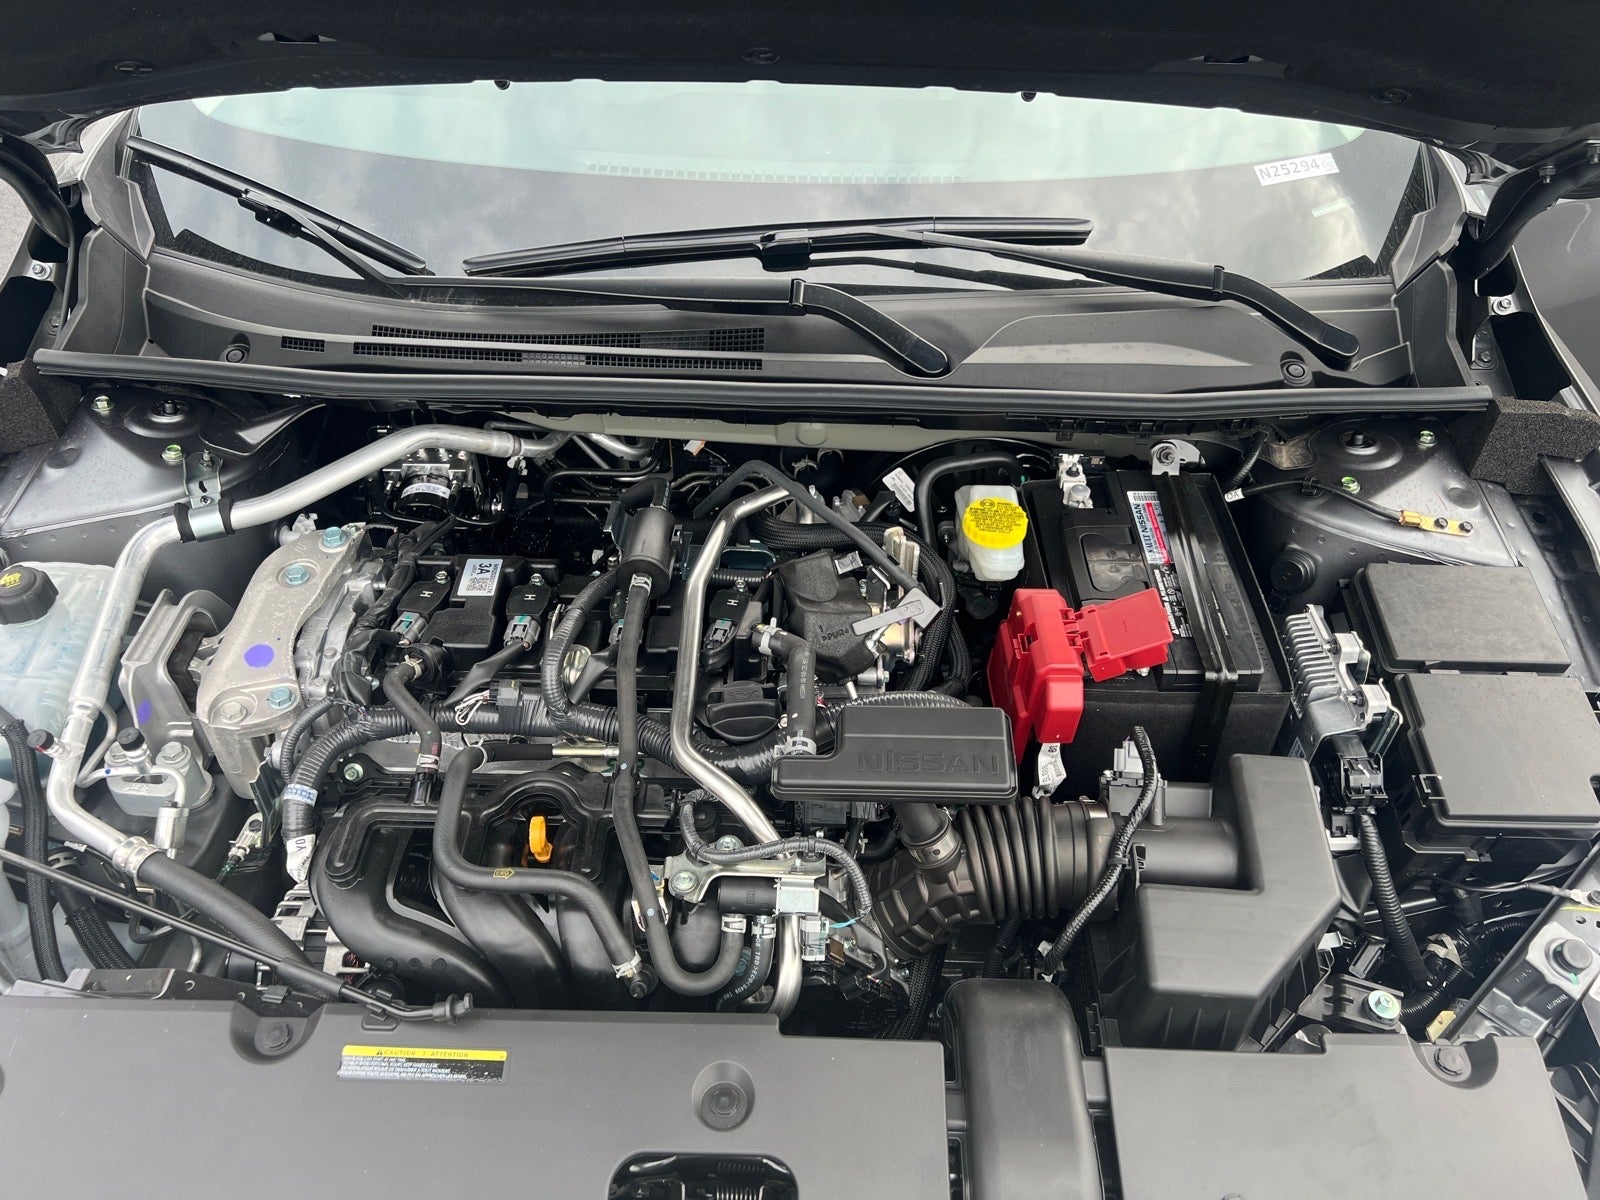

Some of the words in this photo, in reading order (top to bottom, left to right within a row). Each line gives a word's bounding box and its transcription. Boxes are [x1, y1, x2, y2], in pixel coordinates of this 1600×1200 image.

[1132, 503, 1149, 533] NISSAN
[477, 563, 493, 575] 3A
[420, 590, 433, 598] H
[858, 751, 1000, 774] NISSAN
